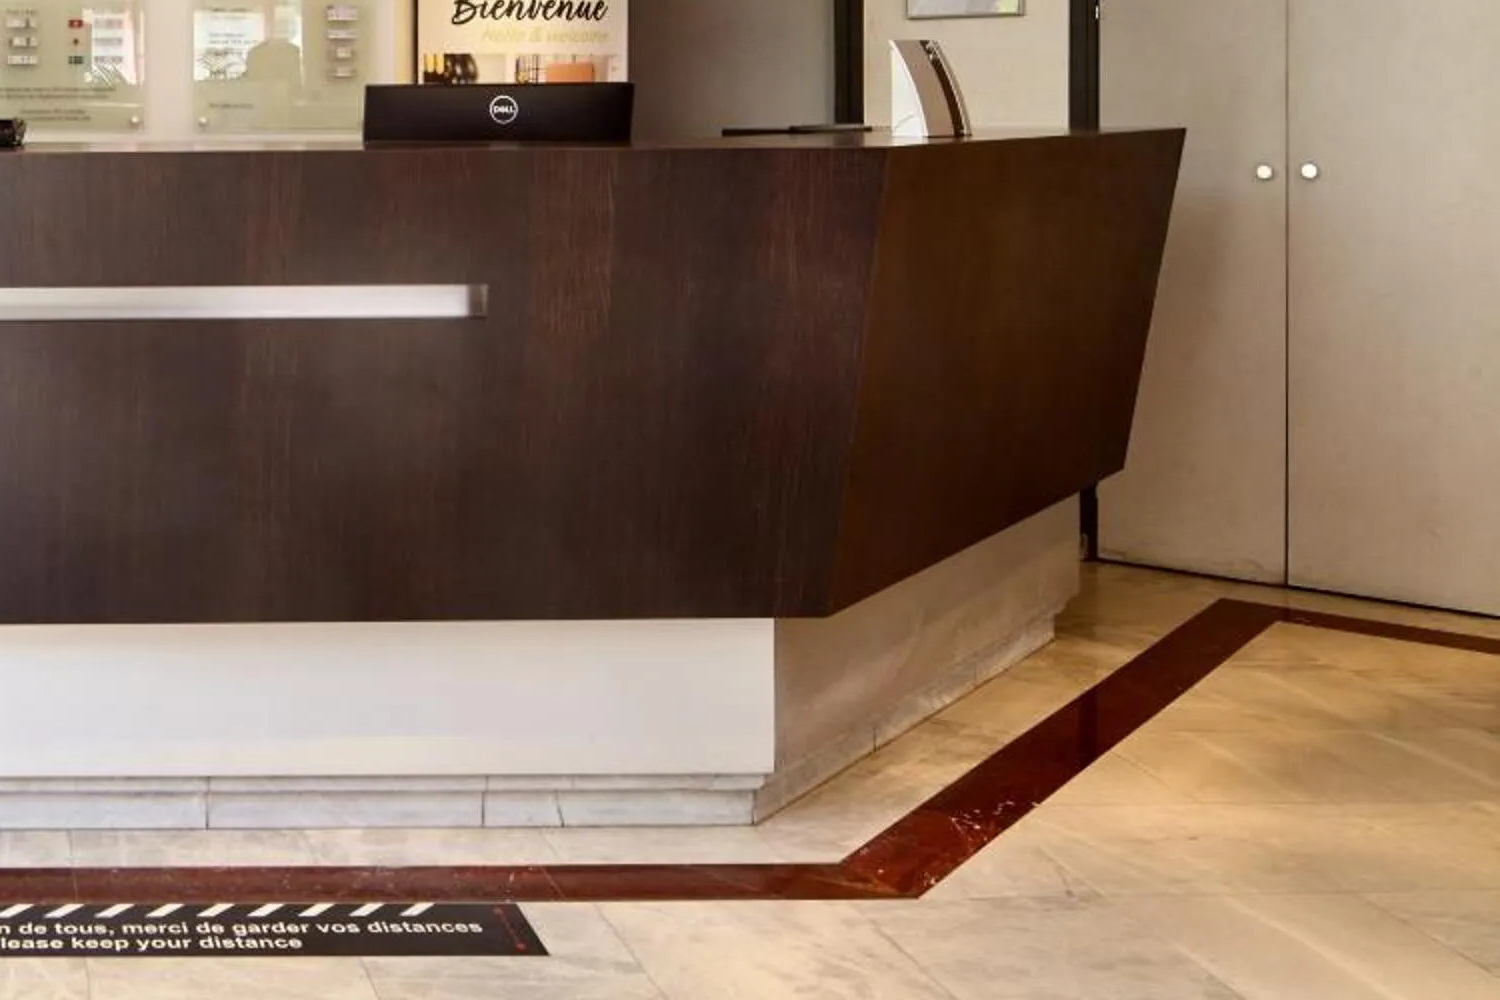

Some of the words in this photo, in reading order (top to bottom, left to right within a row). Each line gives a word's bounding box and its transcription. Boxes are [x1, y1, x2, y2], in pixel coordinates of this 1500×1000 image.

[18, 921, 48, 935] de
[54, 922, 115, 936] tous,
[122, 921, 189, 935] merci
[196, 920, 225, 935] de
[232, 920, 309, 936] garder
[315, 921, 360, 935] vos
[366, 920, 484, 934] distances
[71, 936, 129, 951] keep
[136, 936, 192, 951] your
[199, 935, 304, 950] distance
